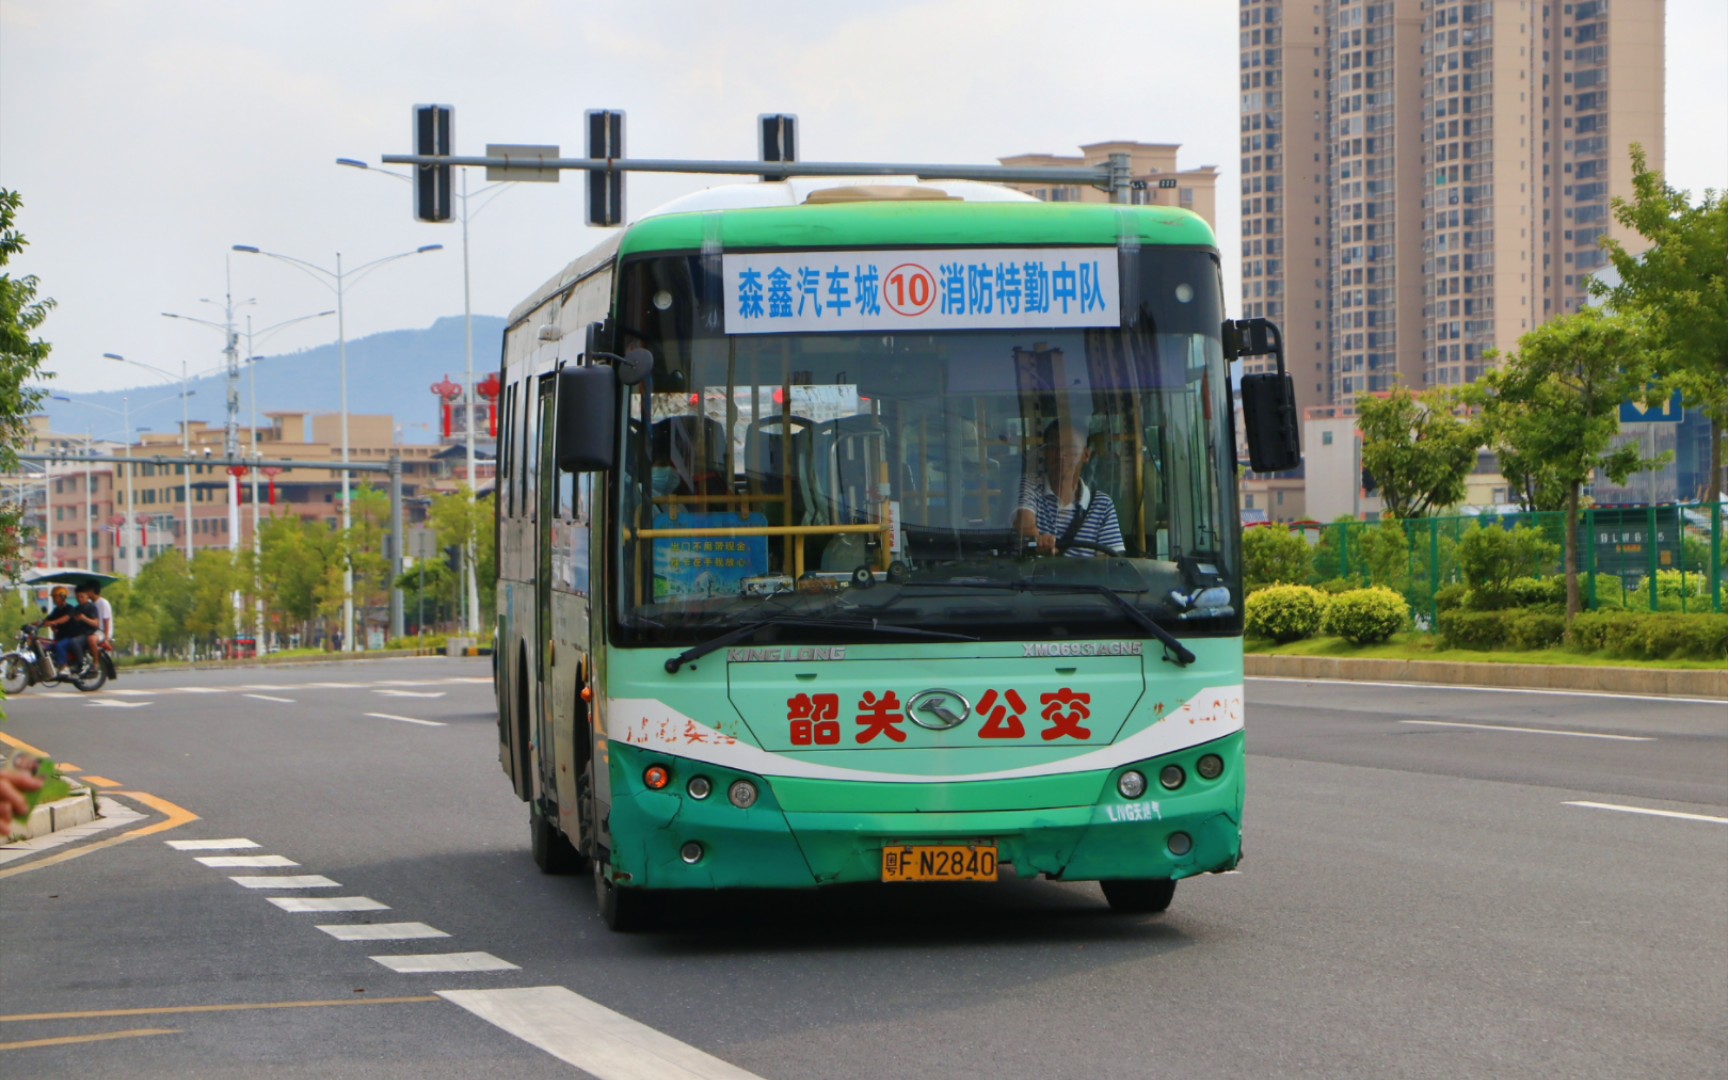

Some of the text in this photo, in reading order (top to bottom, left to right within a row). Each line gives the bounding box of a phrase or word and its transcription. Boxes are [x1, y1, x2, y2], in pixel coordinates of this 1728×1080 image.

[738, 261, 1106, 319] 森鑫汽车城 10 消防特勤中队
[728, 646, 845, 662] KING LONG
[1023, 641, 1143, 656] XMQ6931AGN5
[786, 689, 907, 746] 韶关
[975, 687, 1092, 741] 公交
